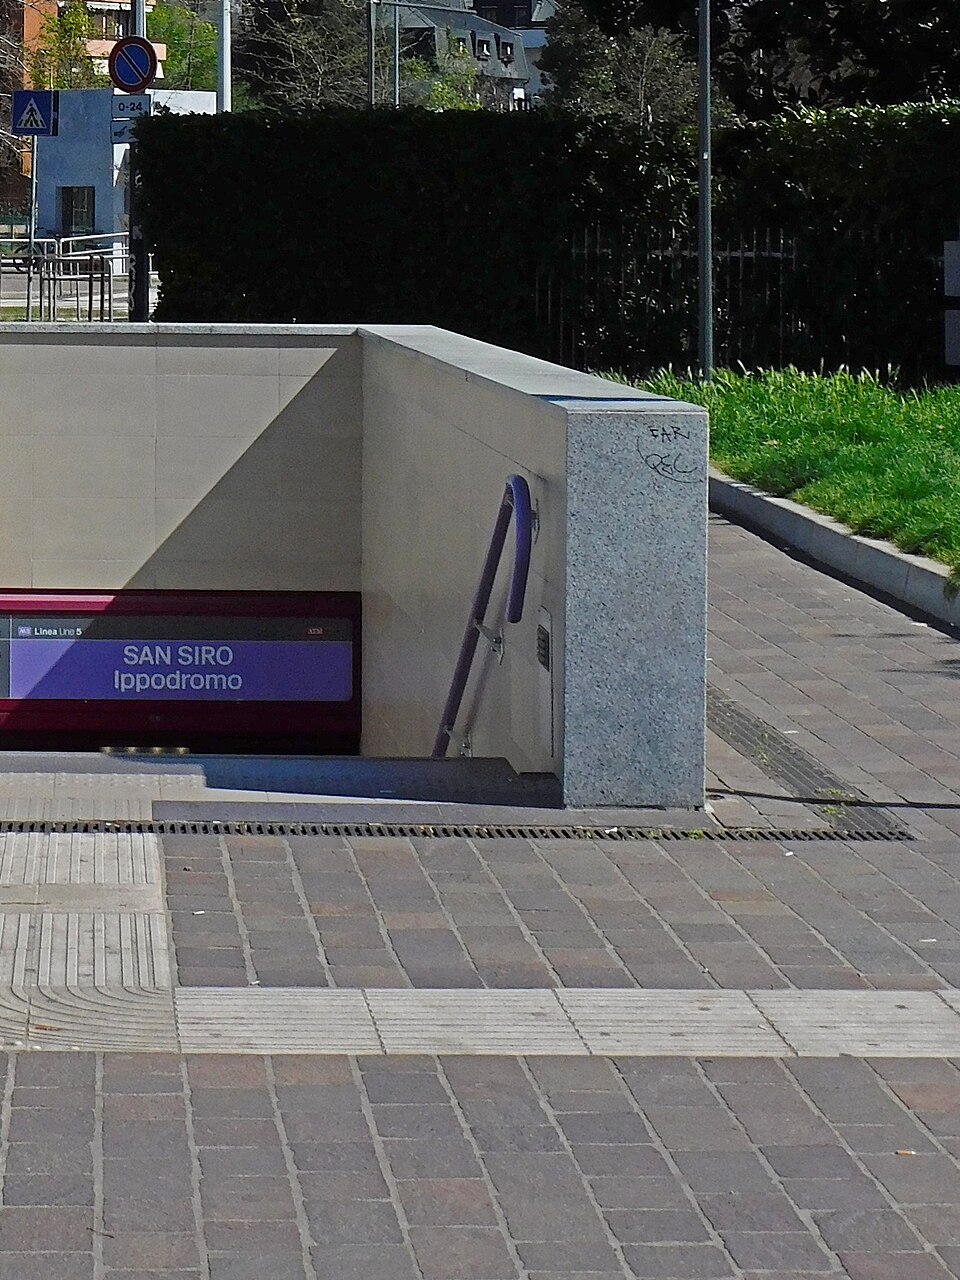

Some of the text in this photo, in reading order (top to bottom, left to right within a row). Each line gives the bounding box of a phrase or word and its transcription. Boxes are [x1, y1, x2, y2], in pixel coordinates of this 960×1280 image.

[118, 101, 143, 112] 0-24
[34, 627, 57, 636] Linea
[76, 627, 82, 636] 5
[123, 645, 234, 666] SAN SIRO
[114, 670, 242, 693] Ippodromo
